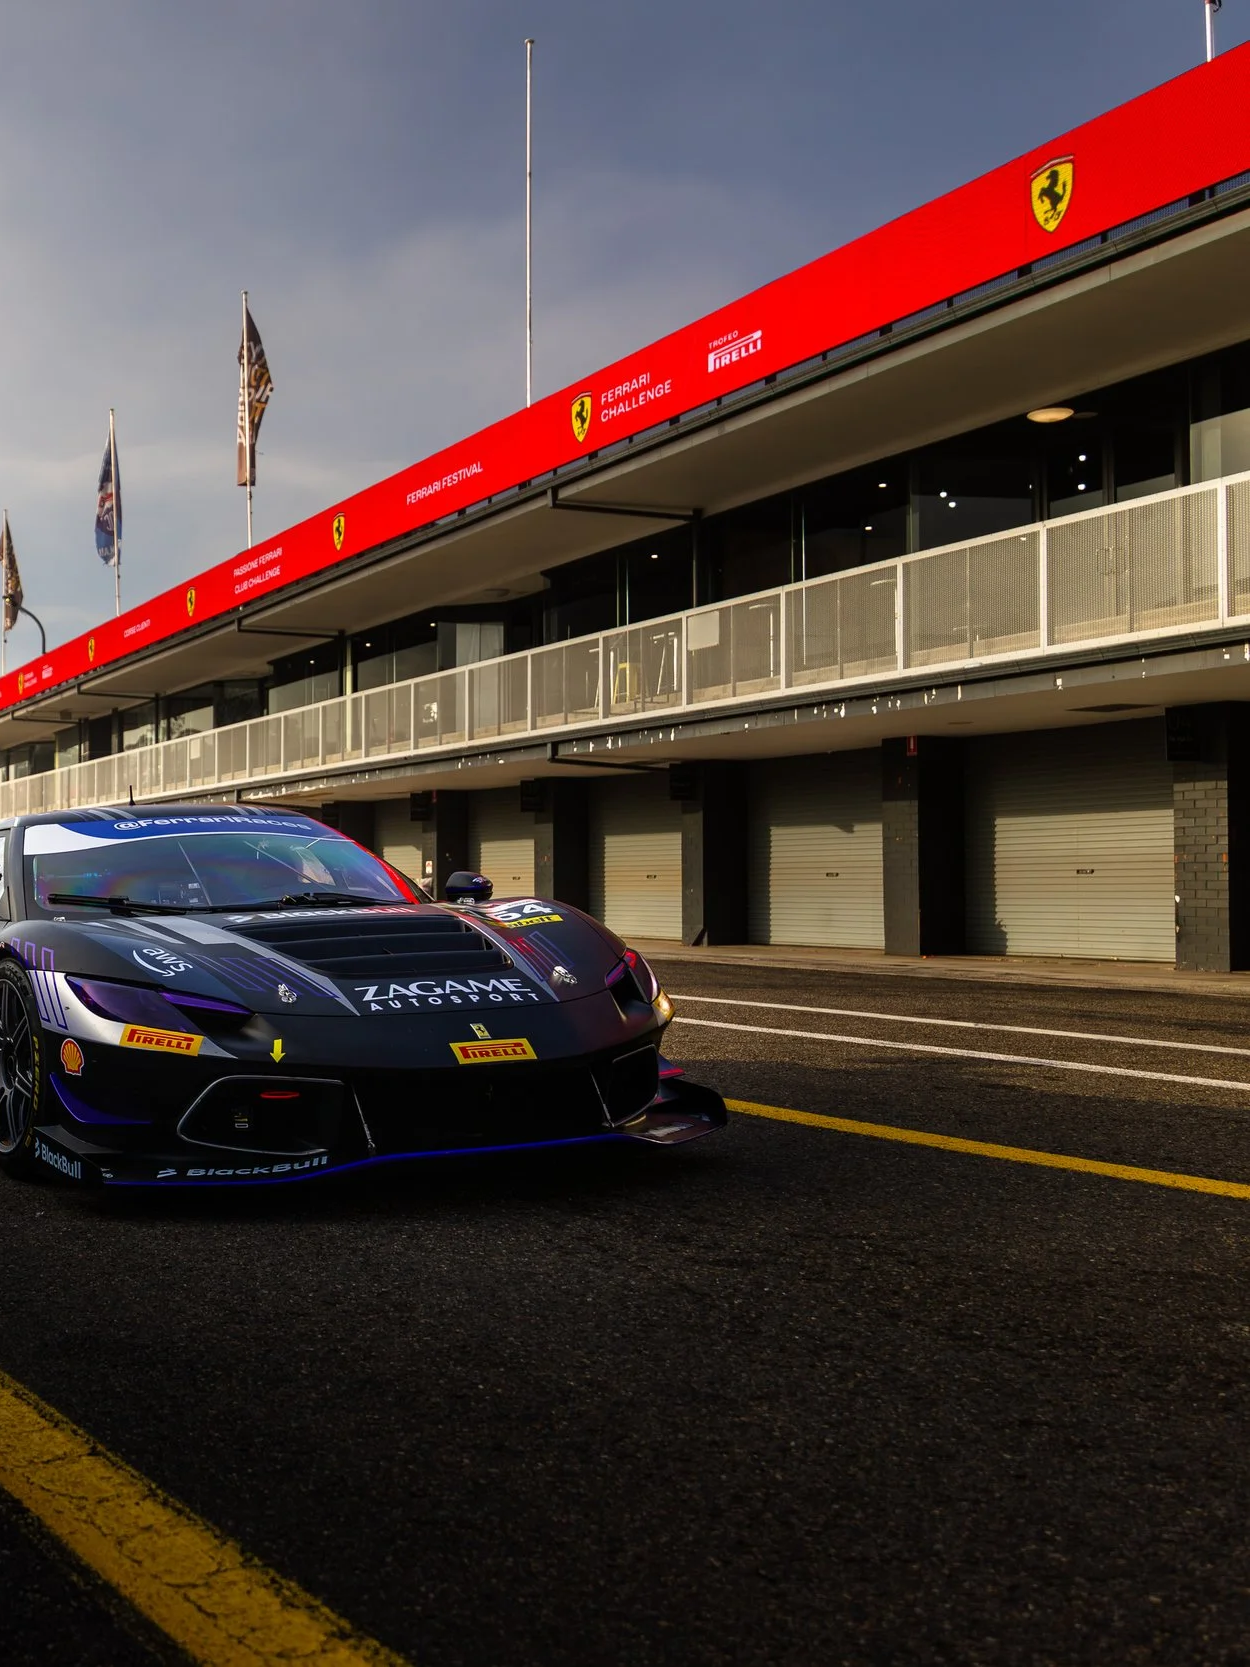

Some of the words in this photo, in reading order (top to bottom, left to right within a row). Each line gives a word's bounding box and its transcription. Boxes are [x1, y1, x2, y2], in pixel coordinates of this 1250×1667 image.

[707, 329, 762, 373] PIRELLI
[708, 330, 739, 350] TROFEO
[601, 372, 650, 405] FERRARI
[600, 380, 672, 422] CHALLENGE
[406, 480, 441, 505] FERRARI
[442, 462, 483, 489] FESTIVAL
[234, 558, 258, 577] PASSIONE
[259, 547, 282, 564] FERRARI
[234, 580, 248, 594] CLUB
[249, 565, 280, 587] CHALLENGE
[114, 816, 311, 831] @FerrariRaces
[258, 907, 416, 920] BlackBull
[142, 948, 193, 972] aws
[355, 978, 532, 1001] ZAGAME
[370, 993, 540, 1012] AUTOSPORT
[126, 1028, 195, 1051] PIRELLI
[458, 1042, 524, 1060] PIRELLI
[41, 1143, 82, 1180] BlackBull
[186, 1155, 328, 1177] BlackBull
